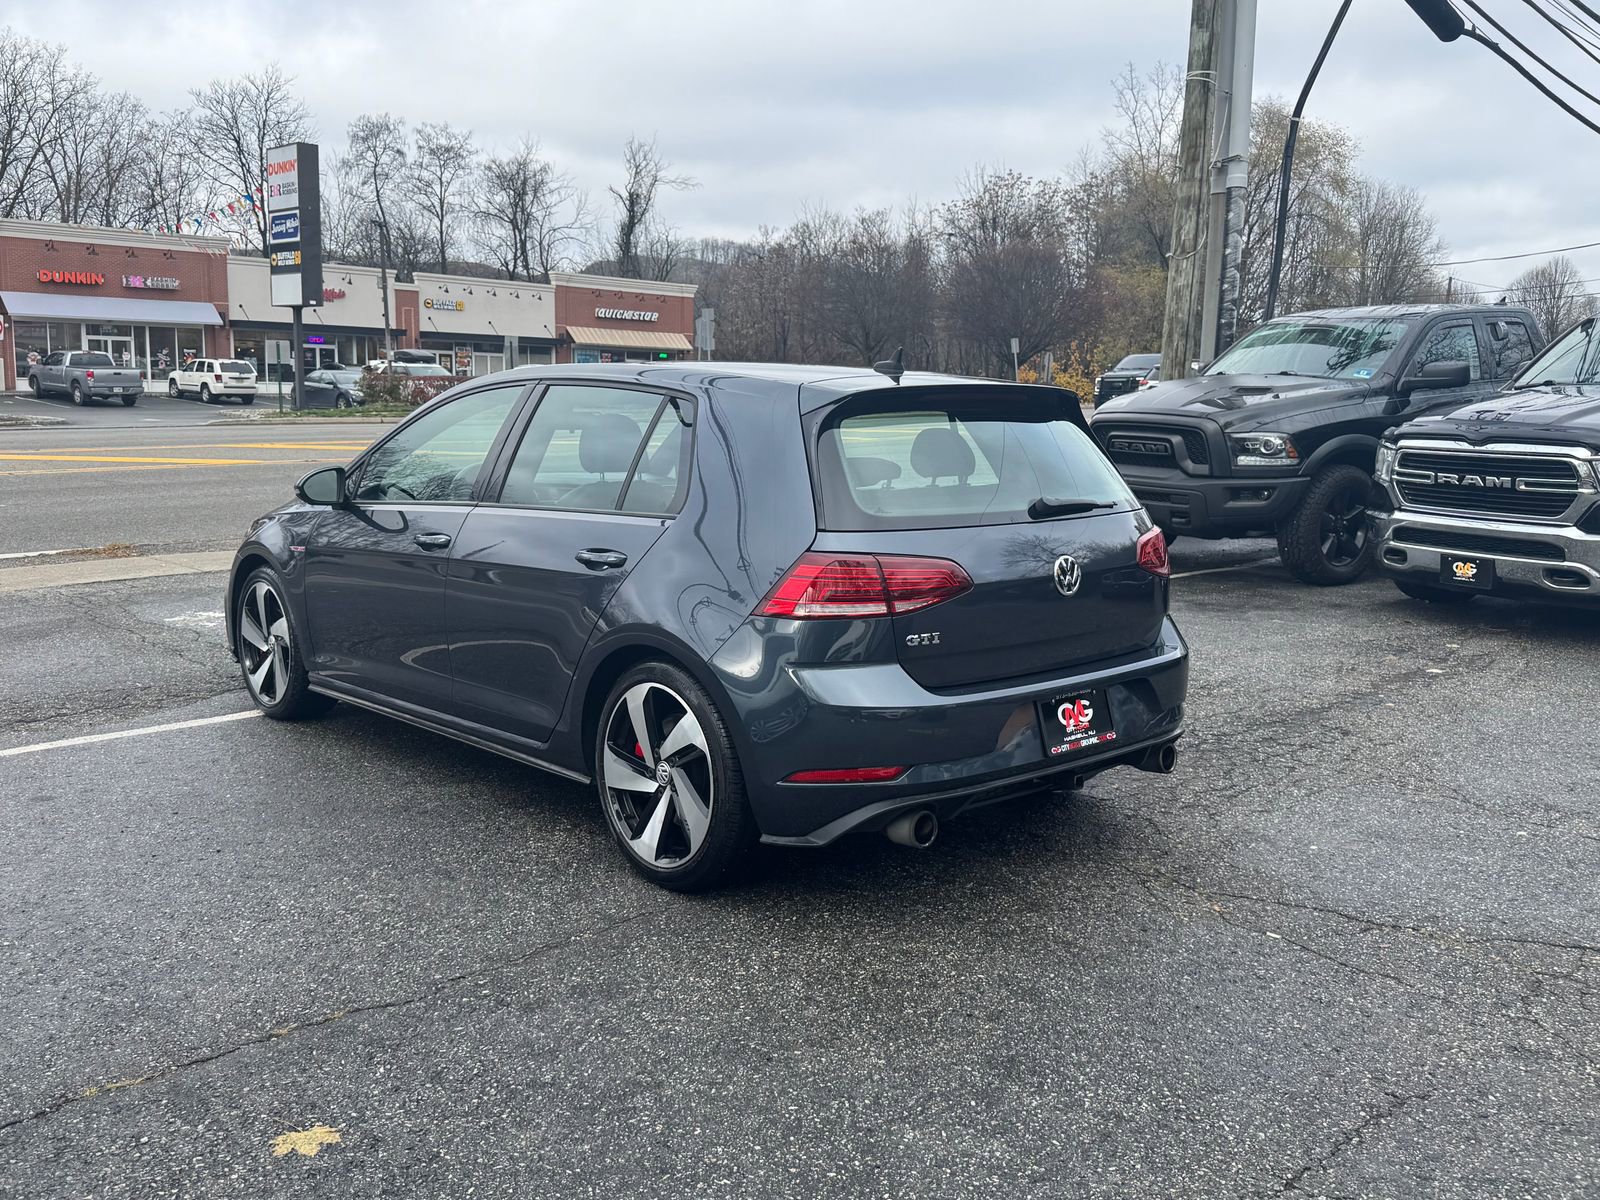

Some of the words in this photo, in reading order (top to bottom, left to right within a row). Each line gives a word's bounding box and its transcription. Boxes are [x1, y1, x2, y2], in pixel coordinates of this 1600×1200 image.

[1112, 441, 1166, 453] RAM
[1437, 472, 1512, 488] RAM
[905, 632, 940, 646] GTI
